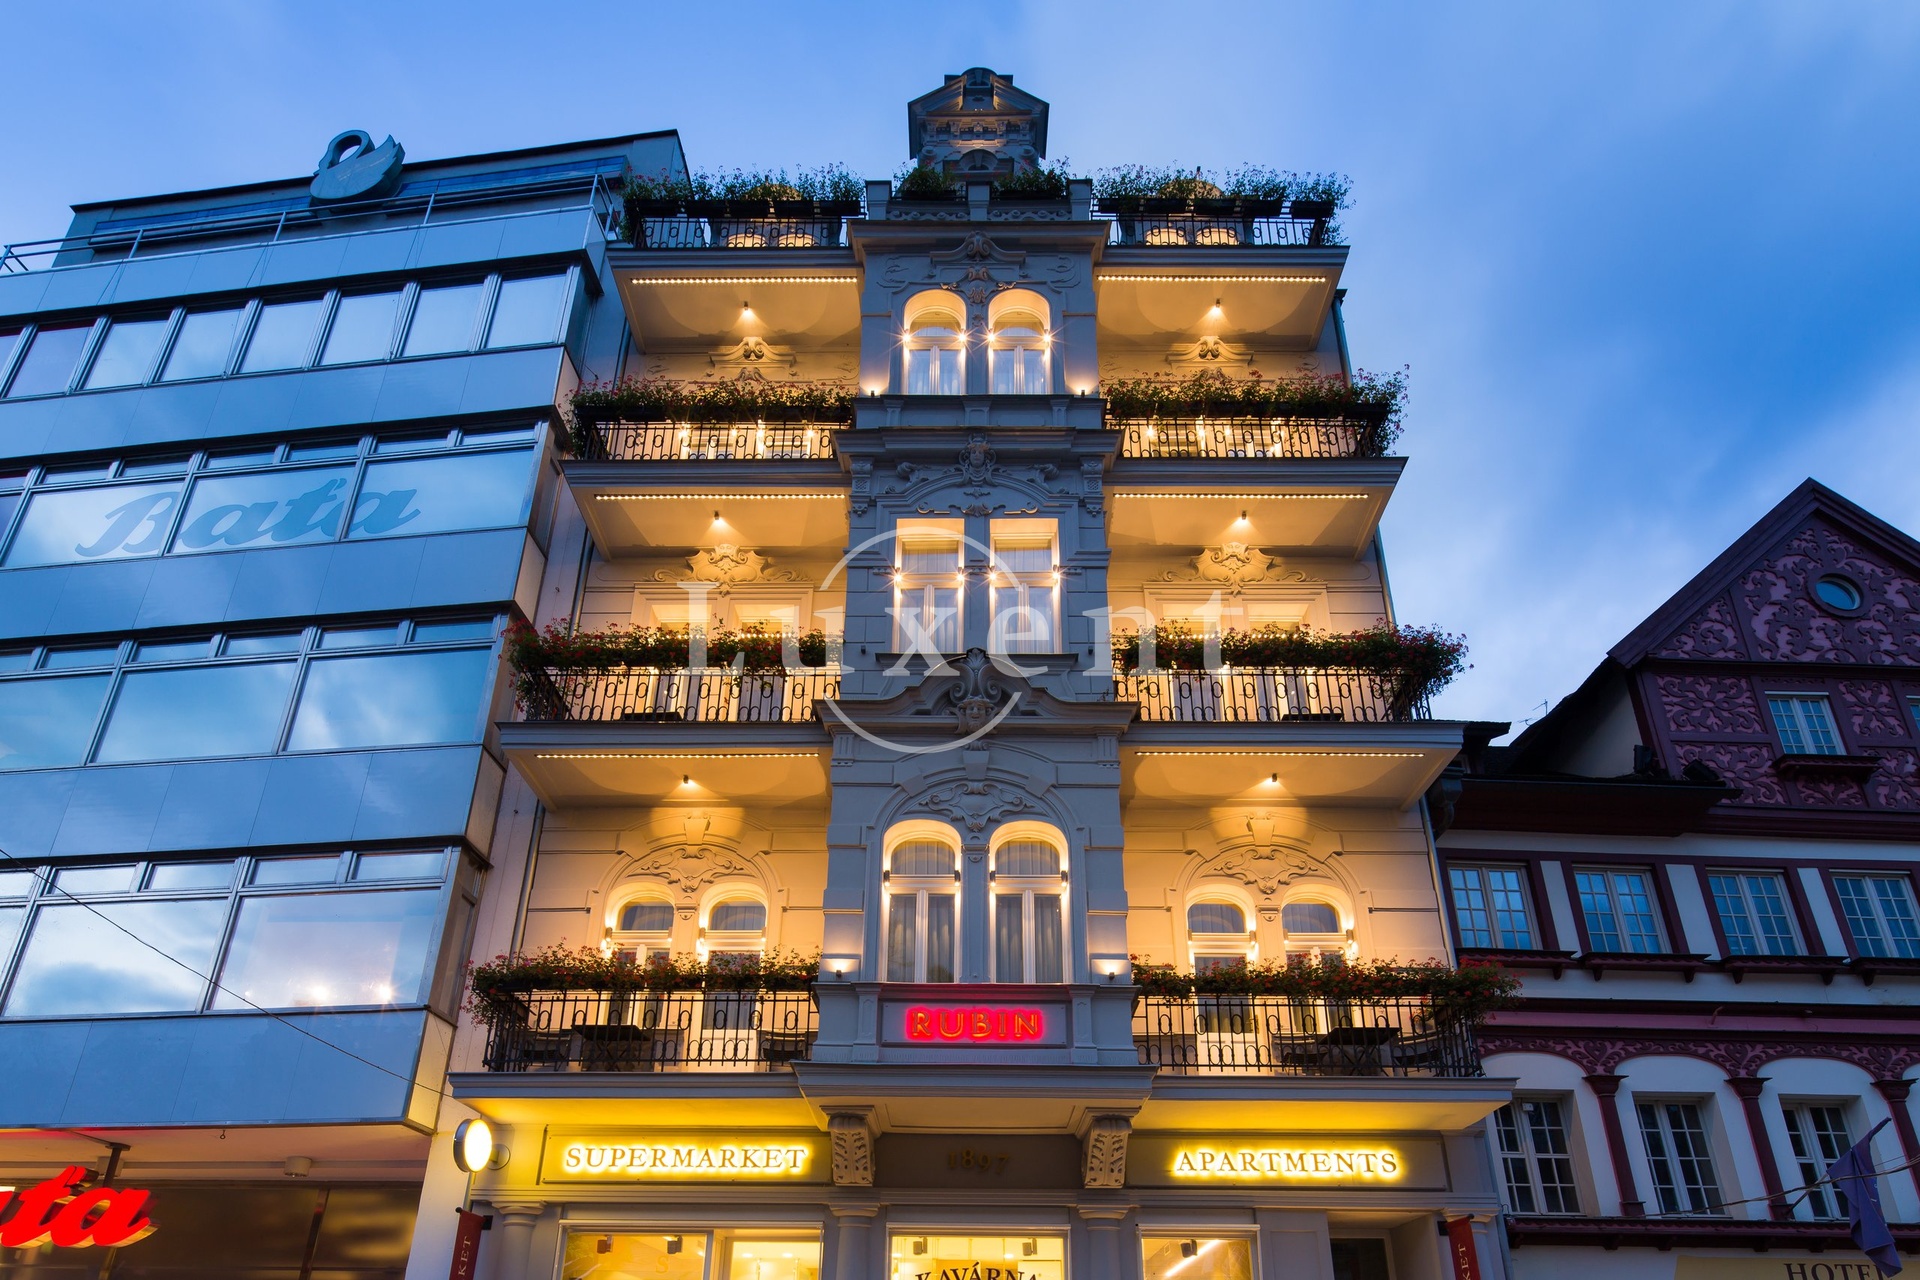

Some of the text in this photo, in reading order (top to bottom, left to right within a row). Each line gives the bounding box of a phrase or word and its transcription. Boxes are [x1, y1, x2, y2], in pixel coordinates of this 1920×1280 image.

[75, 478, 421, 557] Baťa
[912, 1011, 1038, 1038] RUBIN
[564, 1146, 808, 1170] SUPERMARKET
[947, 1148, 1010, 1175] 1897
[1175, 1151, 1399, 1174] APARTMENTS
[0, 1165, 152, 1248] ťa
